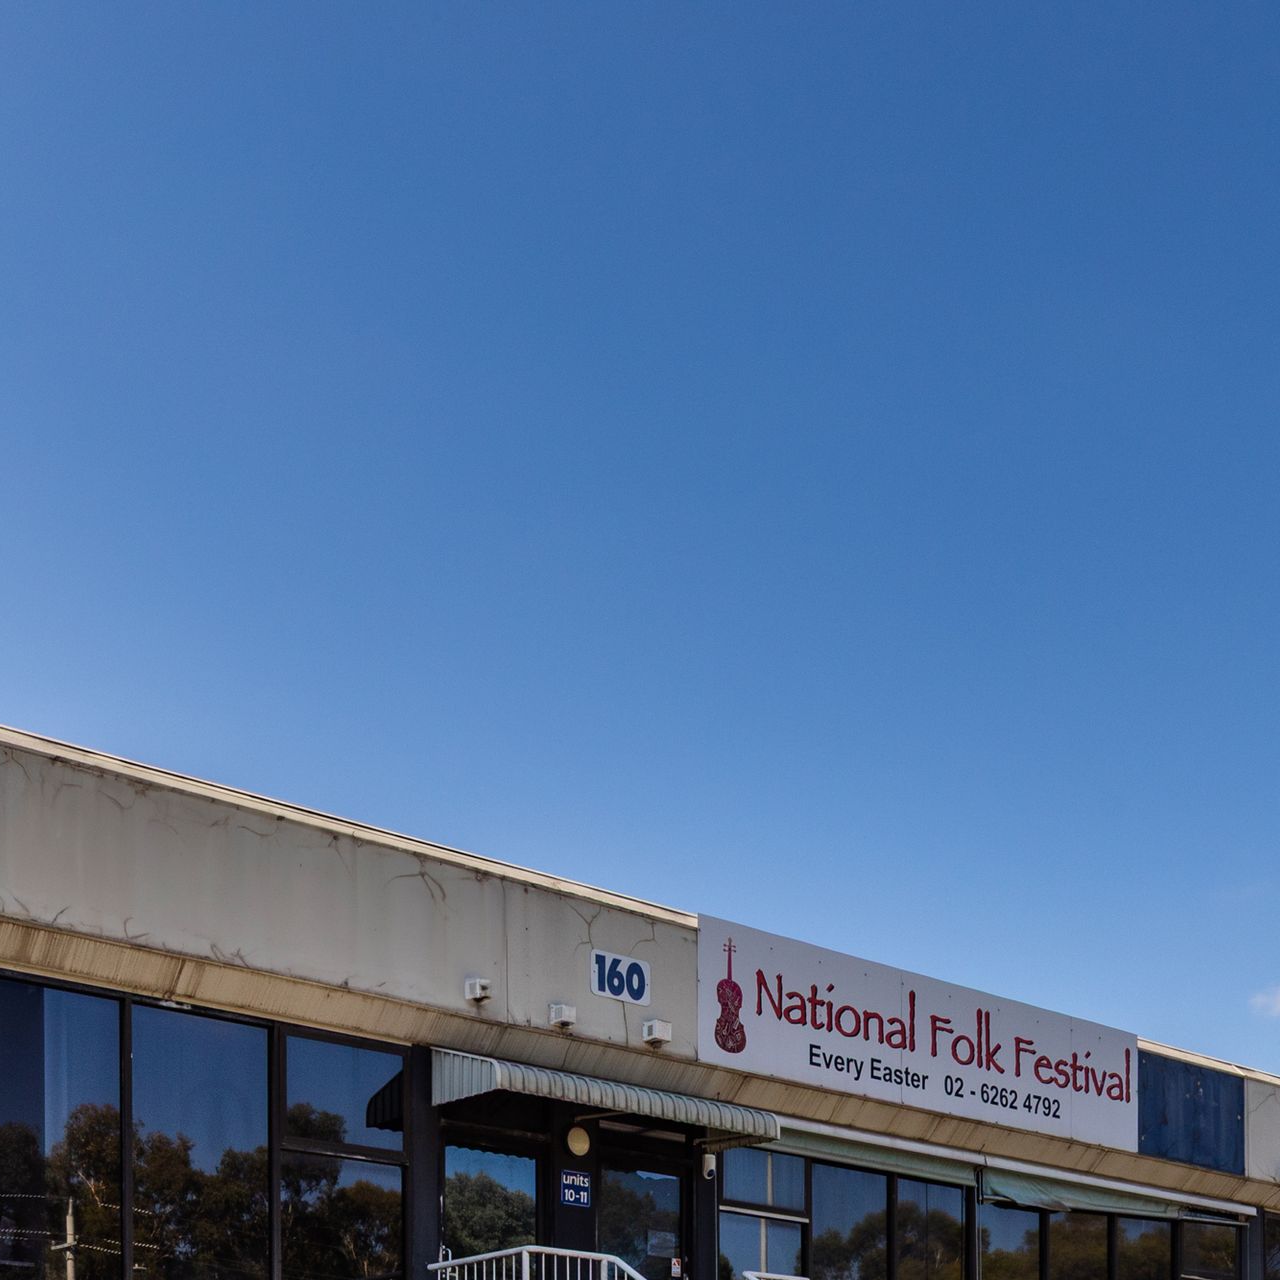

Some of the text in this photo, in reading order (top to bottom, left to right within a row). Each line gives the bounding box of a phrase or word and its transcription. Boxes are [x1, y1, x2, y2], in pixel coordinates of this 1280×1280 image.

[595, 953, 646, 1001] 160
[755, 968, 1131, 1103] National Folk Festival
[809, 1044, 864, 1081] Every
[870, 1058, 929, 1090] Easter
[944, 1075, 964, 1098] 02
[980, 1083, 1018, 1110] 6262
[1023, 1093, 1061, 1119] 4792
[562, 1174, 589, 1188] units
[564, 1189, 588, 1204] 10-11
